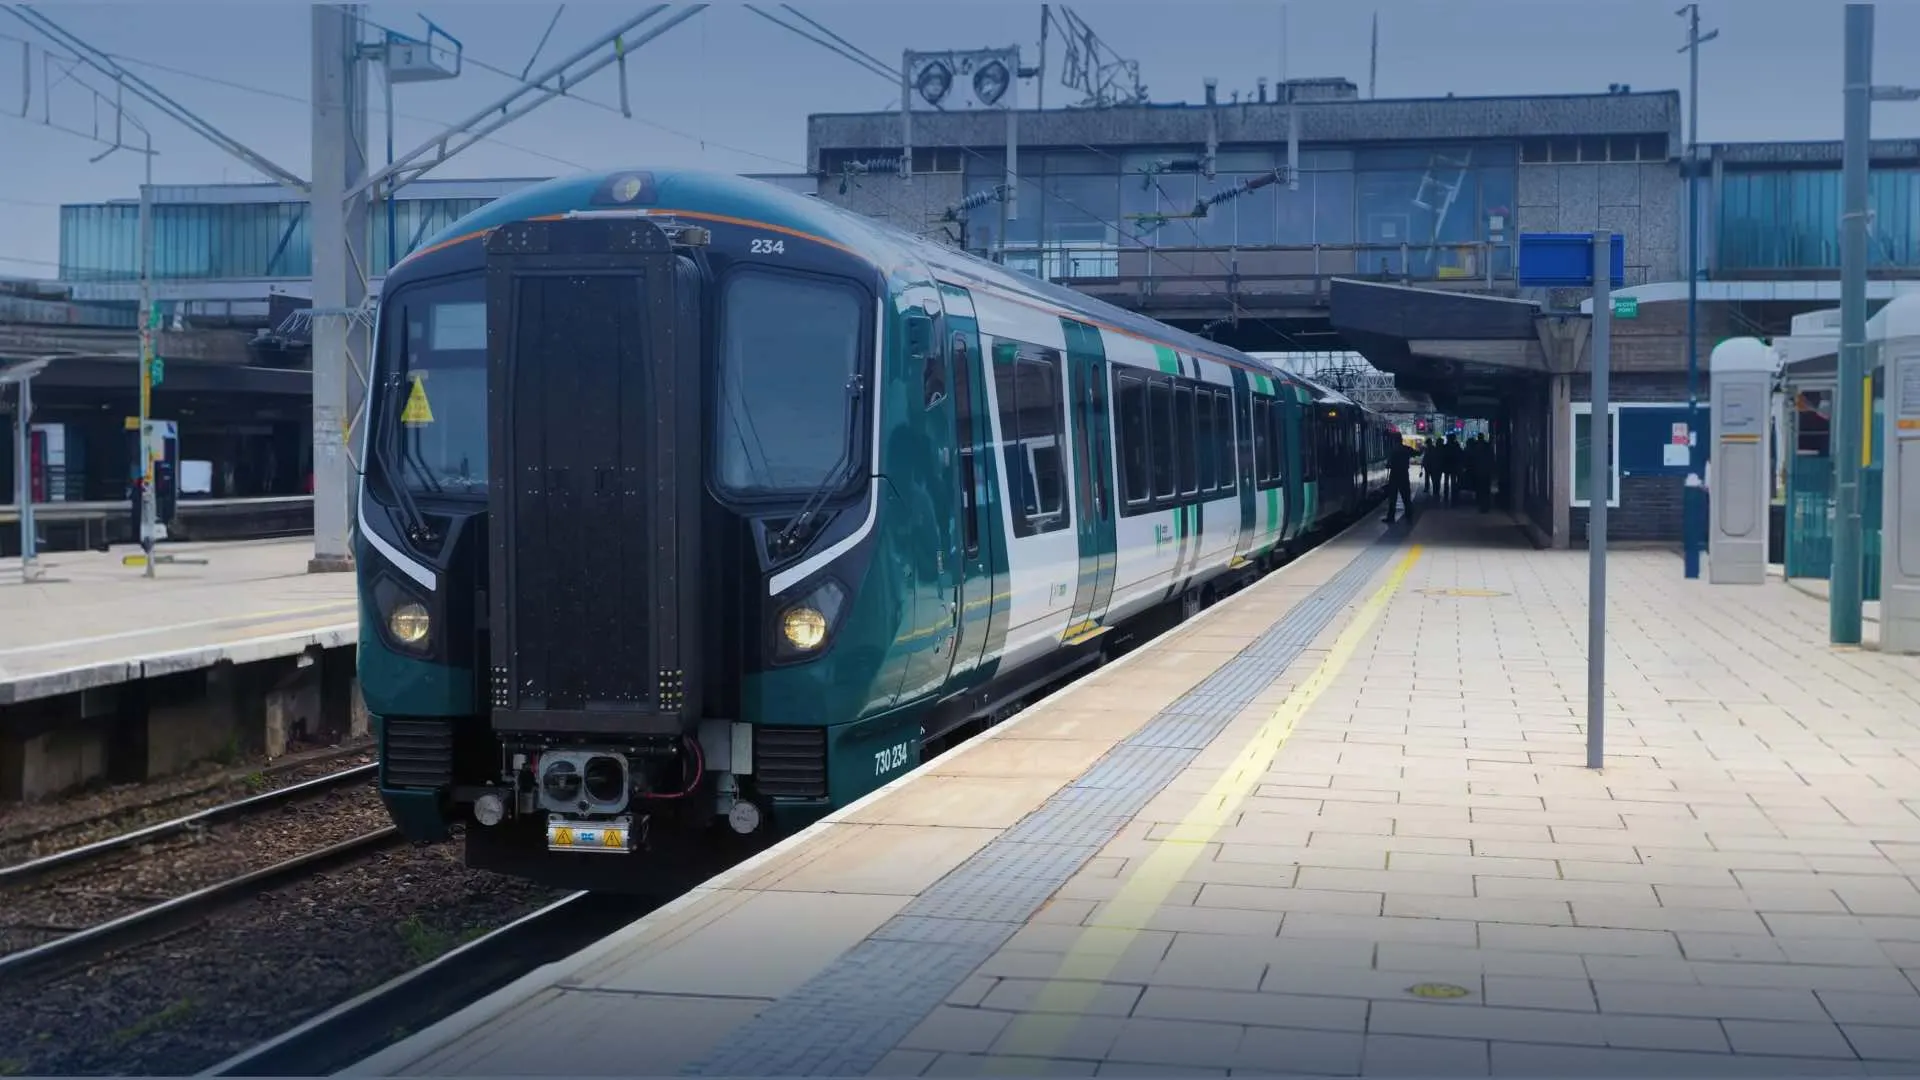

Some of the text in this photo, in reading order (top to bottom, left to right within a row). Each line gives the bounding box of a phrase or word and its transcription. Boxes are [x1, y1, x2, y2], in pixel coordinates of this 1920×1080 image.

[751, 239, 785, 254] 234
[875, 741, 908, 777] 730 234
